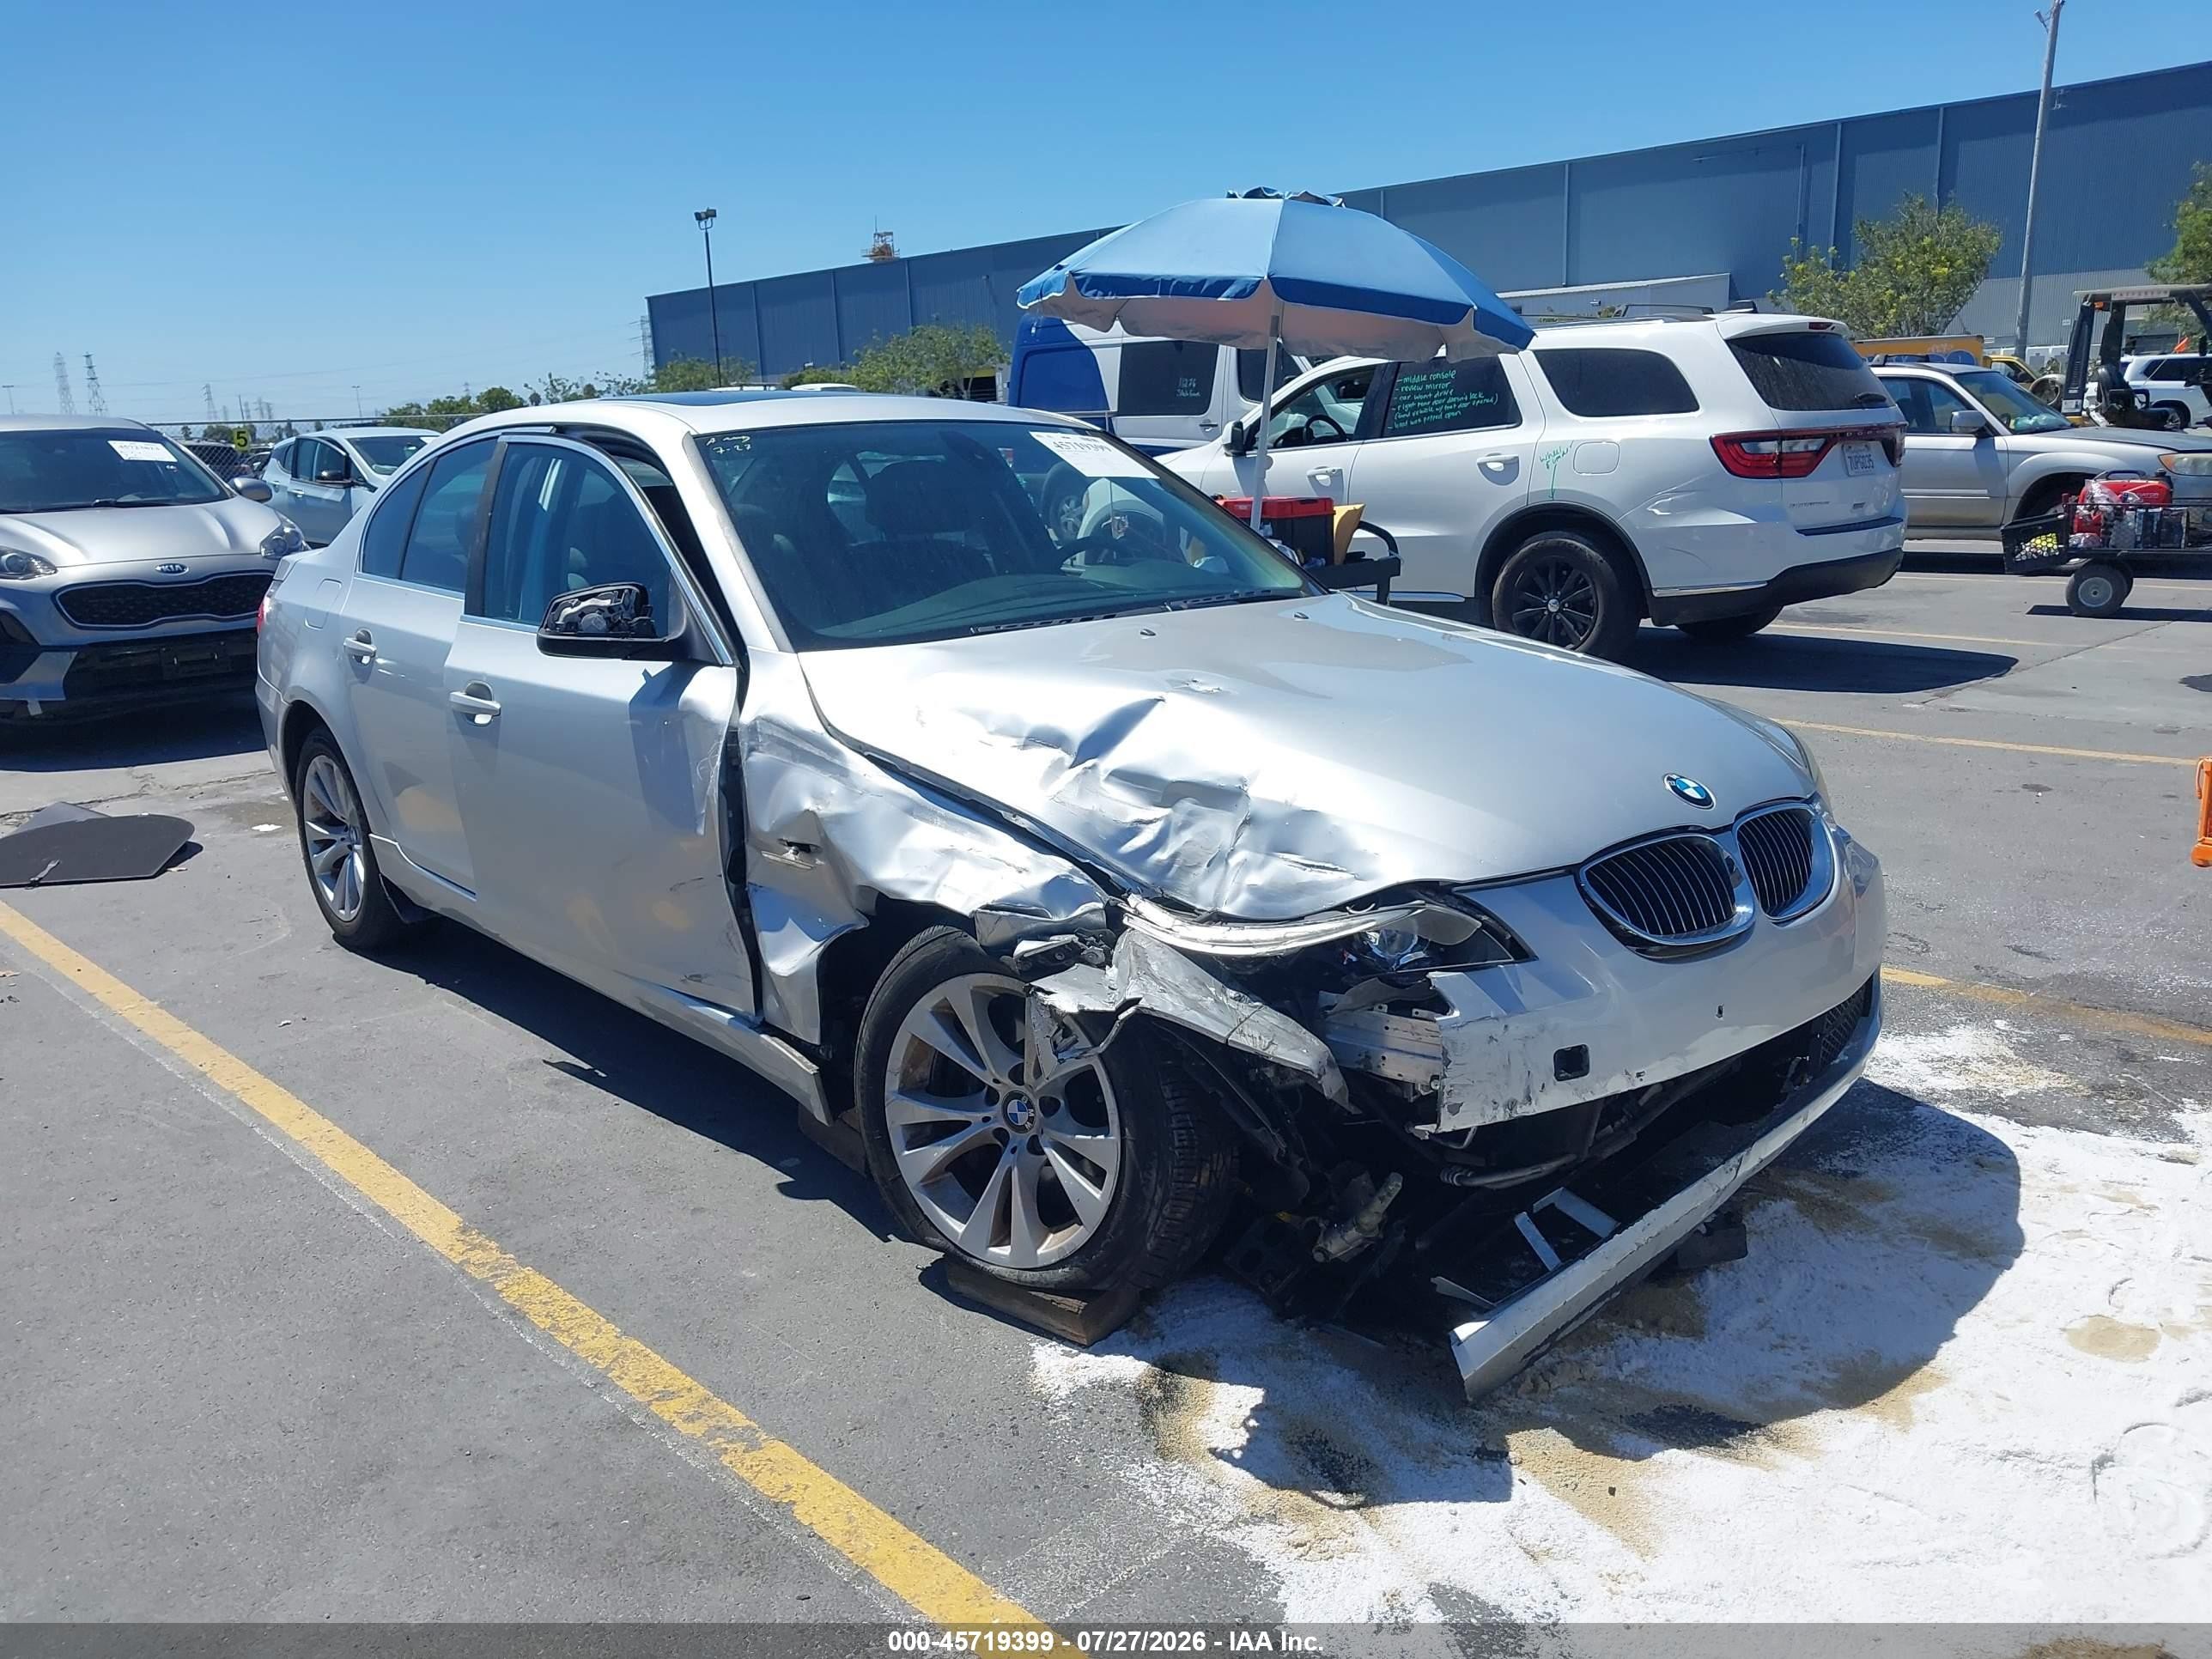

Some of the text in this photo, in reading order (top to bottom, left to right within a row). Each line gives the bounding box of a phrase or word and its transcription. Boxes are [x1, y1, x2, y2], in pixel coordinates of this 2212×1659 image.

[1403, 374, 1427, 384] middle
[1430, 369, 1456, 380] console
[1433, 389, 1454, 398] drive
[235, 430, 248, 447] 5
[1021, 1096, 1035, 1130] BMW
